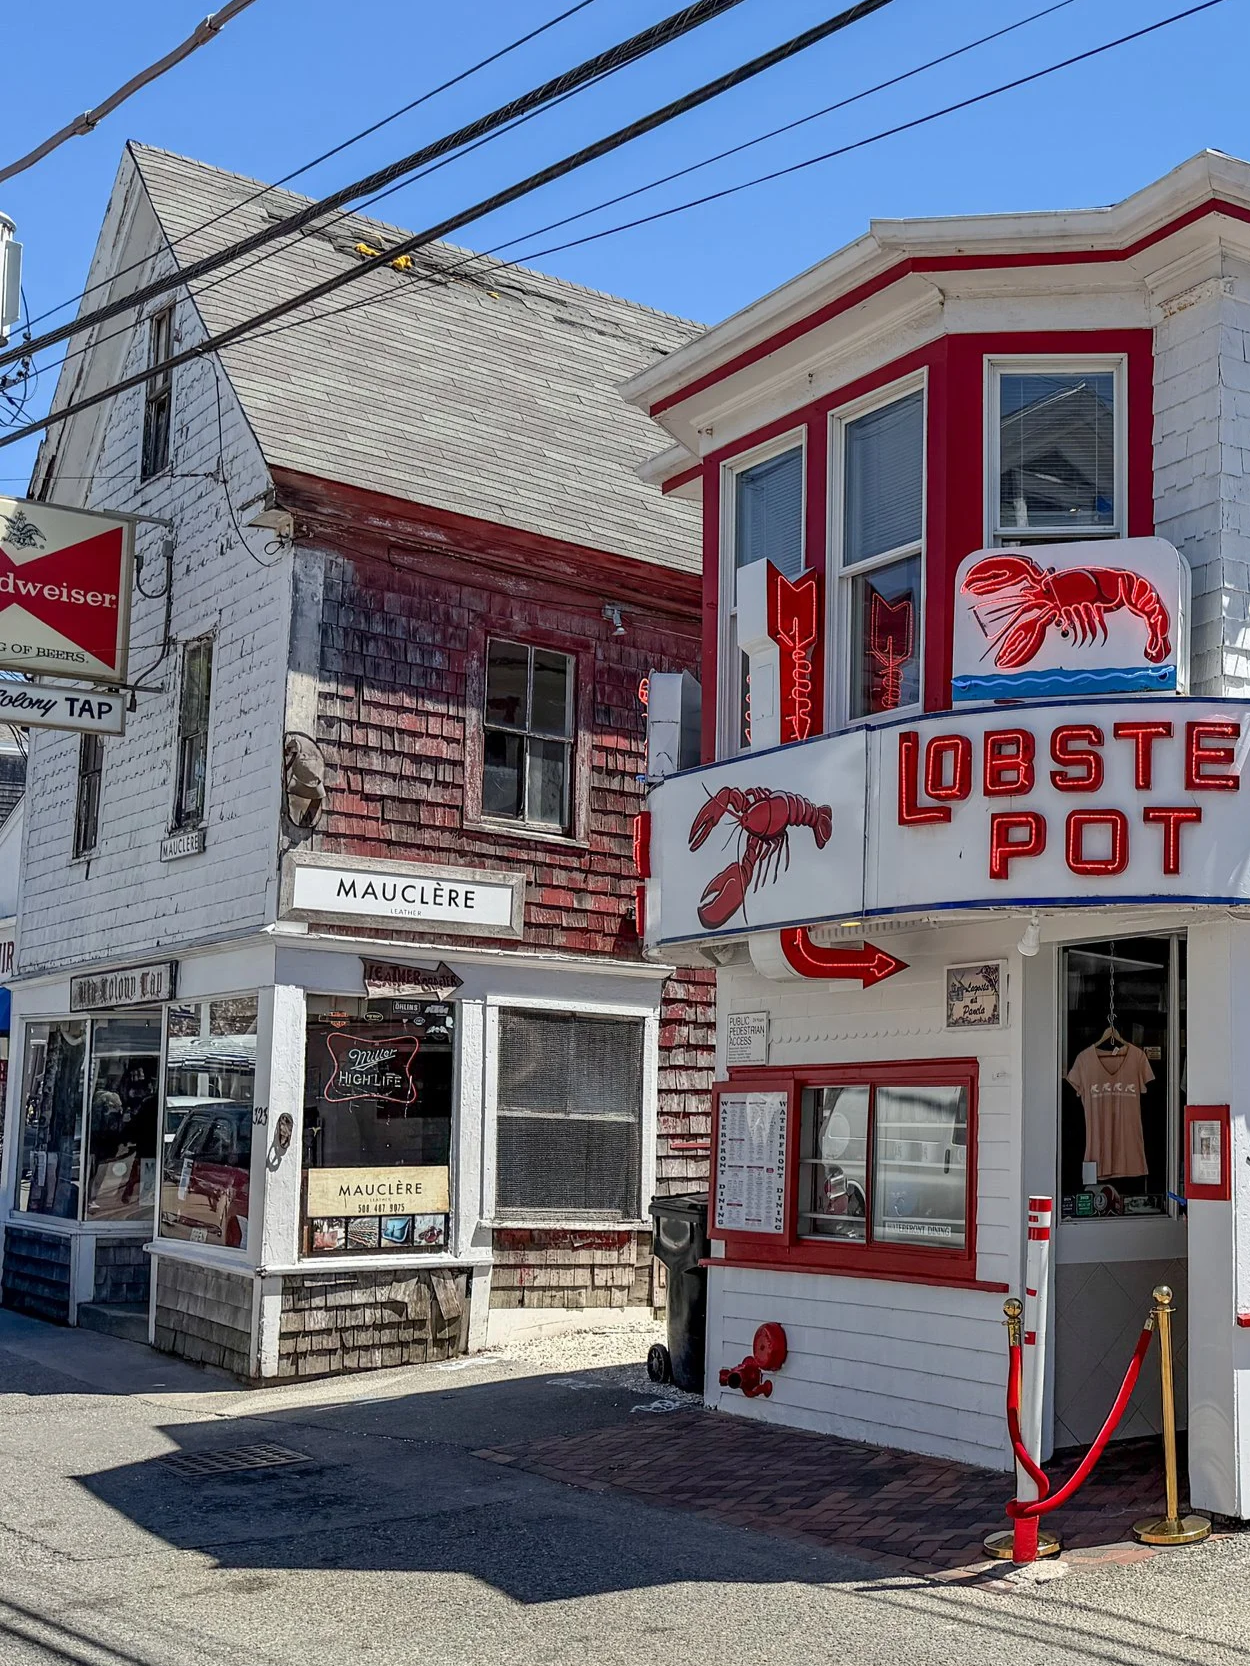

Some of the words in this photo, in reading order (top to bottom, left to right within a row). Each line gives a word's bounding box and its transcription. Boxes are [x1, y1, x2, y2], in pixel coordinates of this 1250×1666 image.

[11, 643, 33, 655] OF
[65, 697, 112, 720] TAP
[989, 807, 1202, 880] POT
[336, 878, 475, 909] MAUCLÈRE
[390, 908, 422, 917] LEATHER
[730, 1016, 750, 1026] PUBLIC
[730, 1025, 764, 1036] PEDESTRIAN
[729, 1036, 752, 1046] ACCESS
[348, 1048, 398, 1071] Miller
[339, 1070, 371, 1086] HIGH
[373, 1072, 402, 1088] LIFE
[719, 1101, 729, 1175] WATERFRONT
[777, 1101, 787, 1179] WATERFRONT
[338, 1180, 422, 1197] MAUCLÈRE
[717, 1184, 726, 1225] DINING
[774, 1188, 784, 1231] DINING
[927, 1226, 951, 1237] DINING
